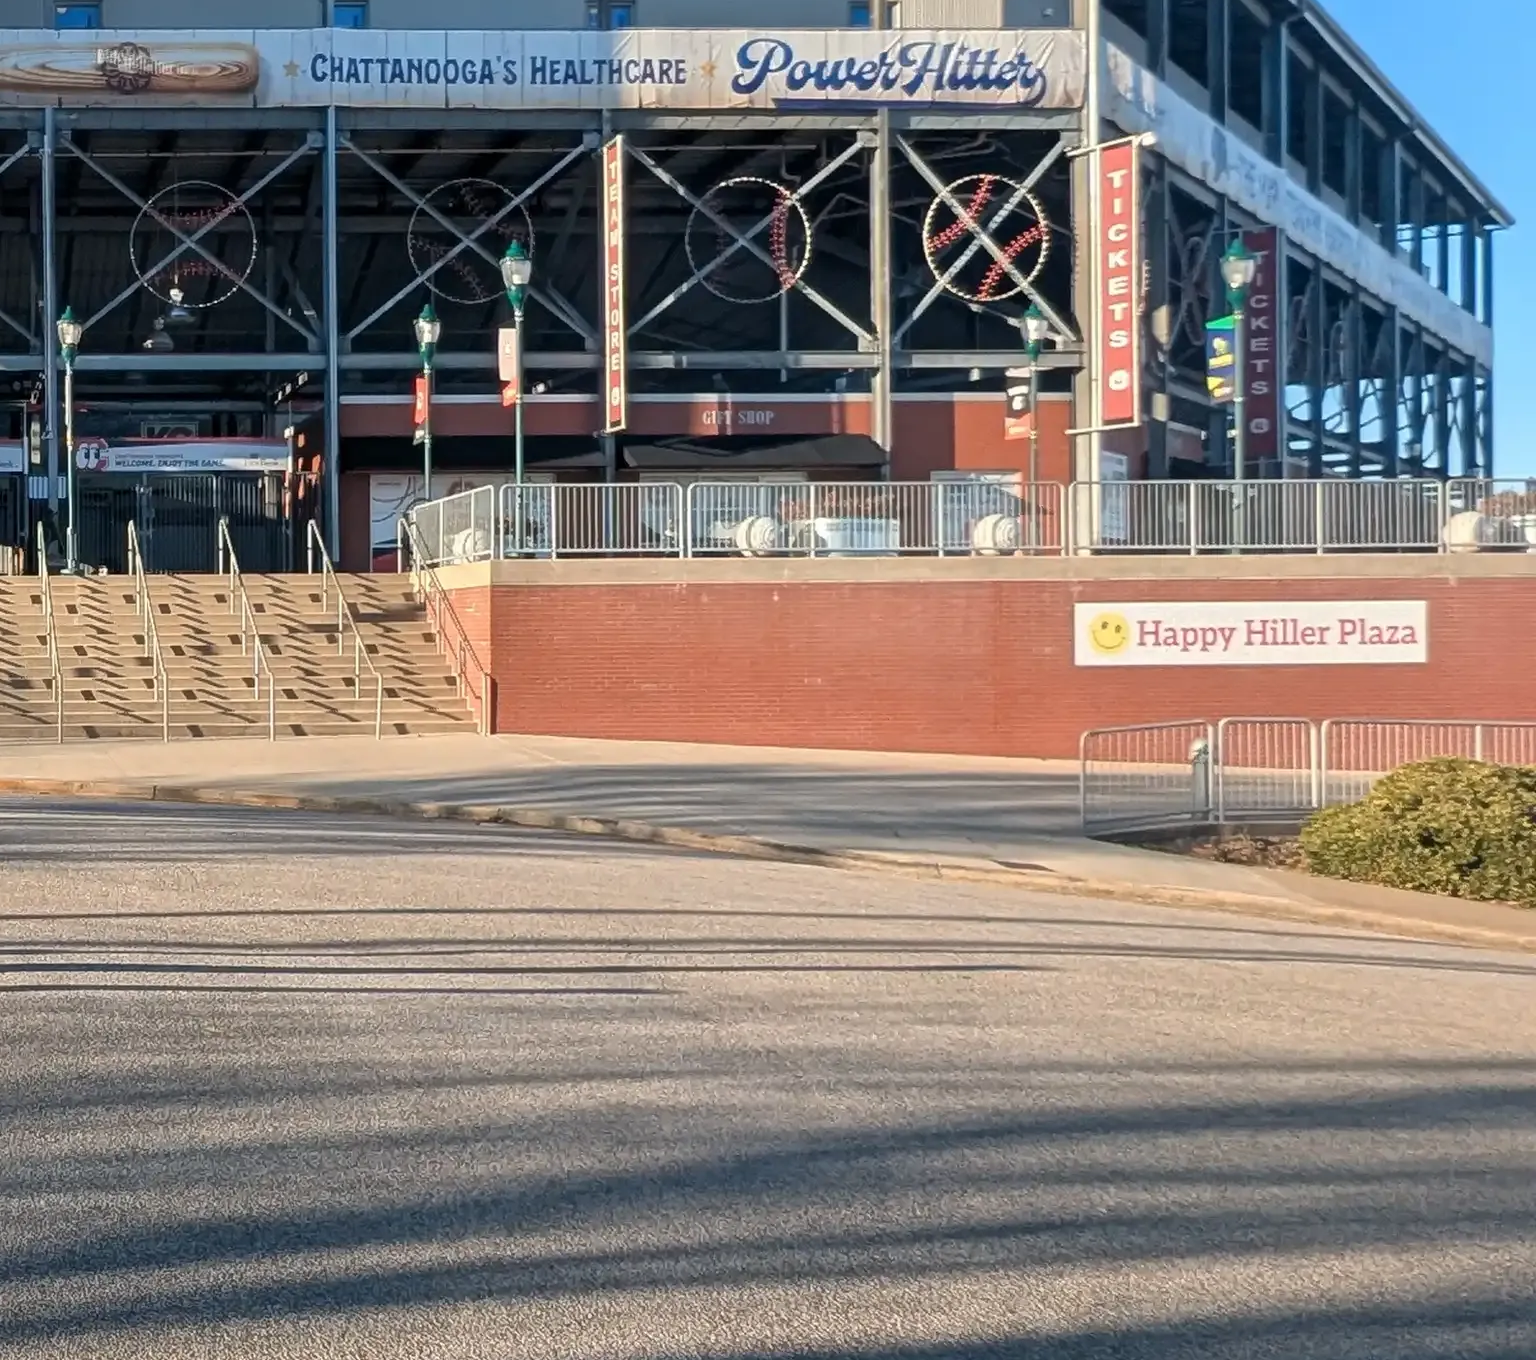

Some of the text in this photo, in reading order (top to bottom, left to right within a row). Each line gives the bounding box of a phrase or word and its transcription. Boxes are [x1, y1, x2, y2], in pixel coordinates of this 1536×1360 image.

[309, 38, 1047, 107] CHATTANOOGA'S HEALTHCARE Power Hitter
[608, 162, 621, 371] TEAM STORE
[1106, 168, 1130, 349] TICKETS
[1249, 251, 1270, 396] TICKETS
[702, 409, 775, 425] GIFT SHOP
[1136, 618, 1418, 653] Happy Hiller Plaza
